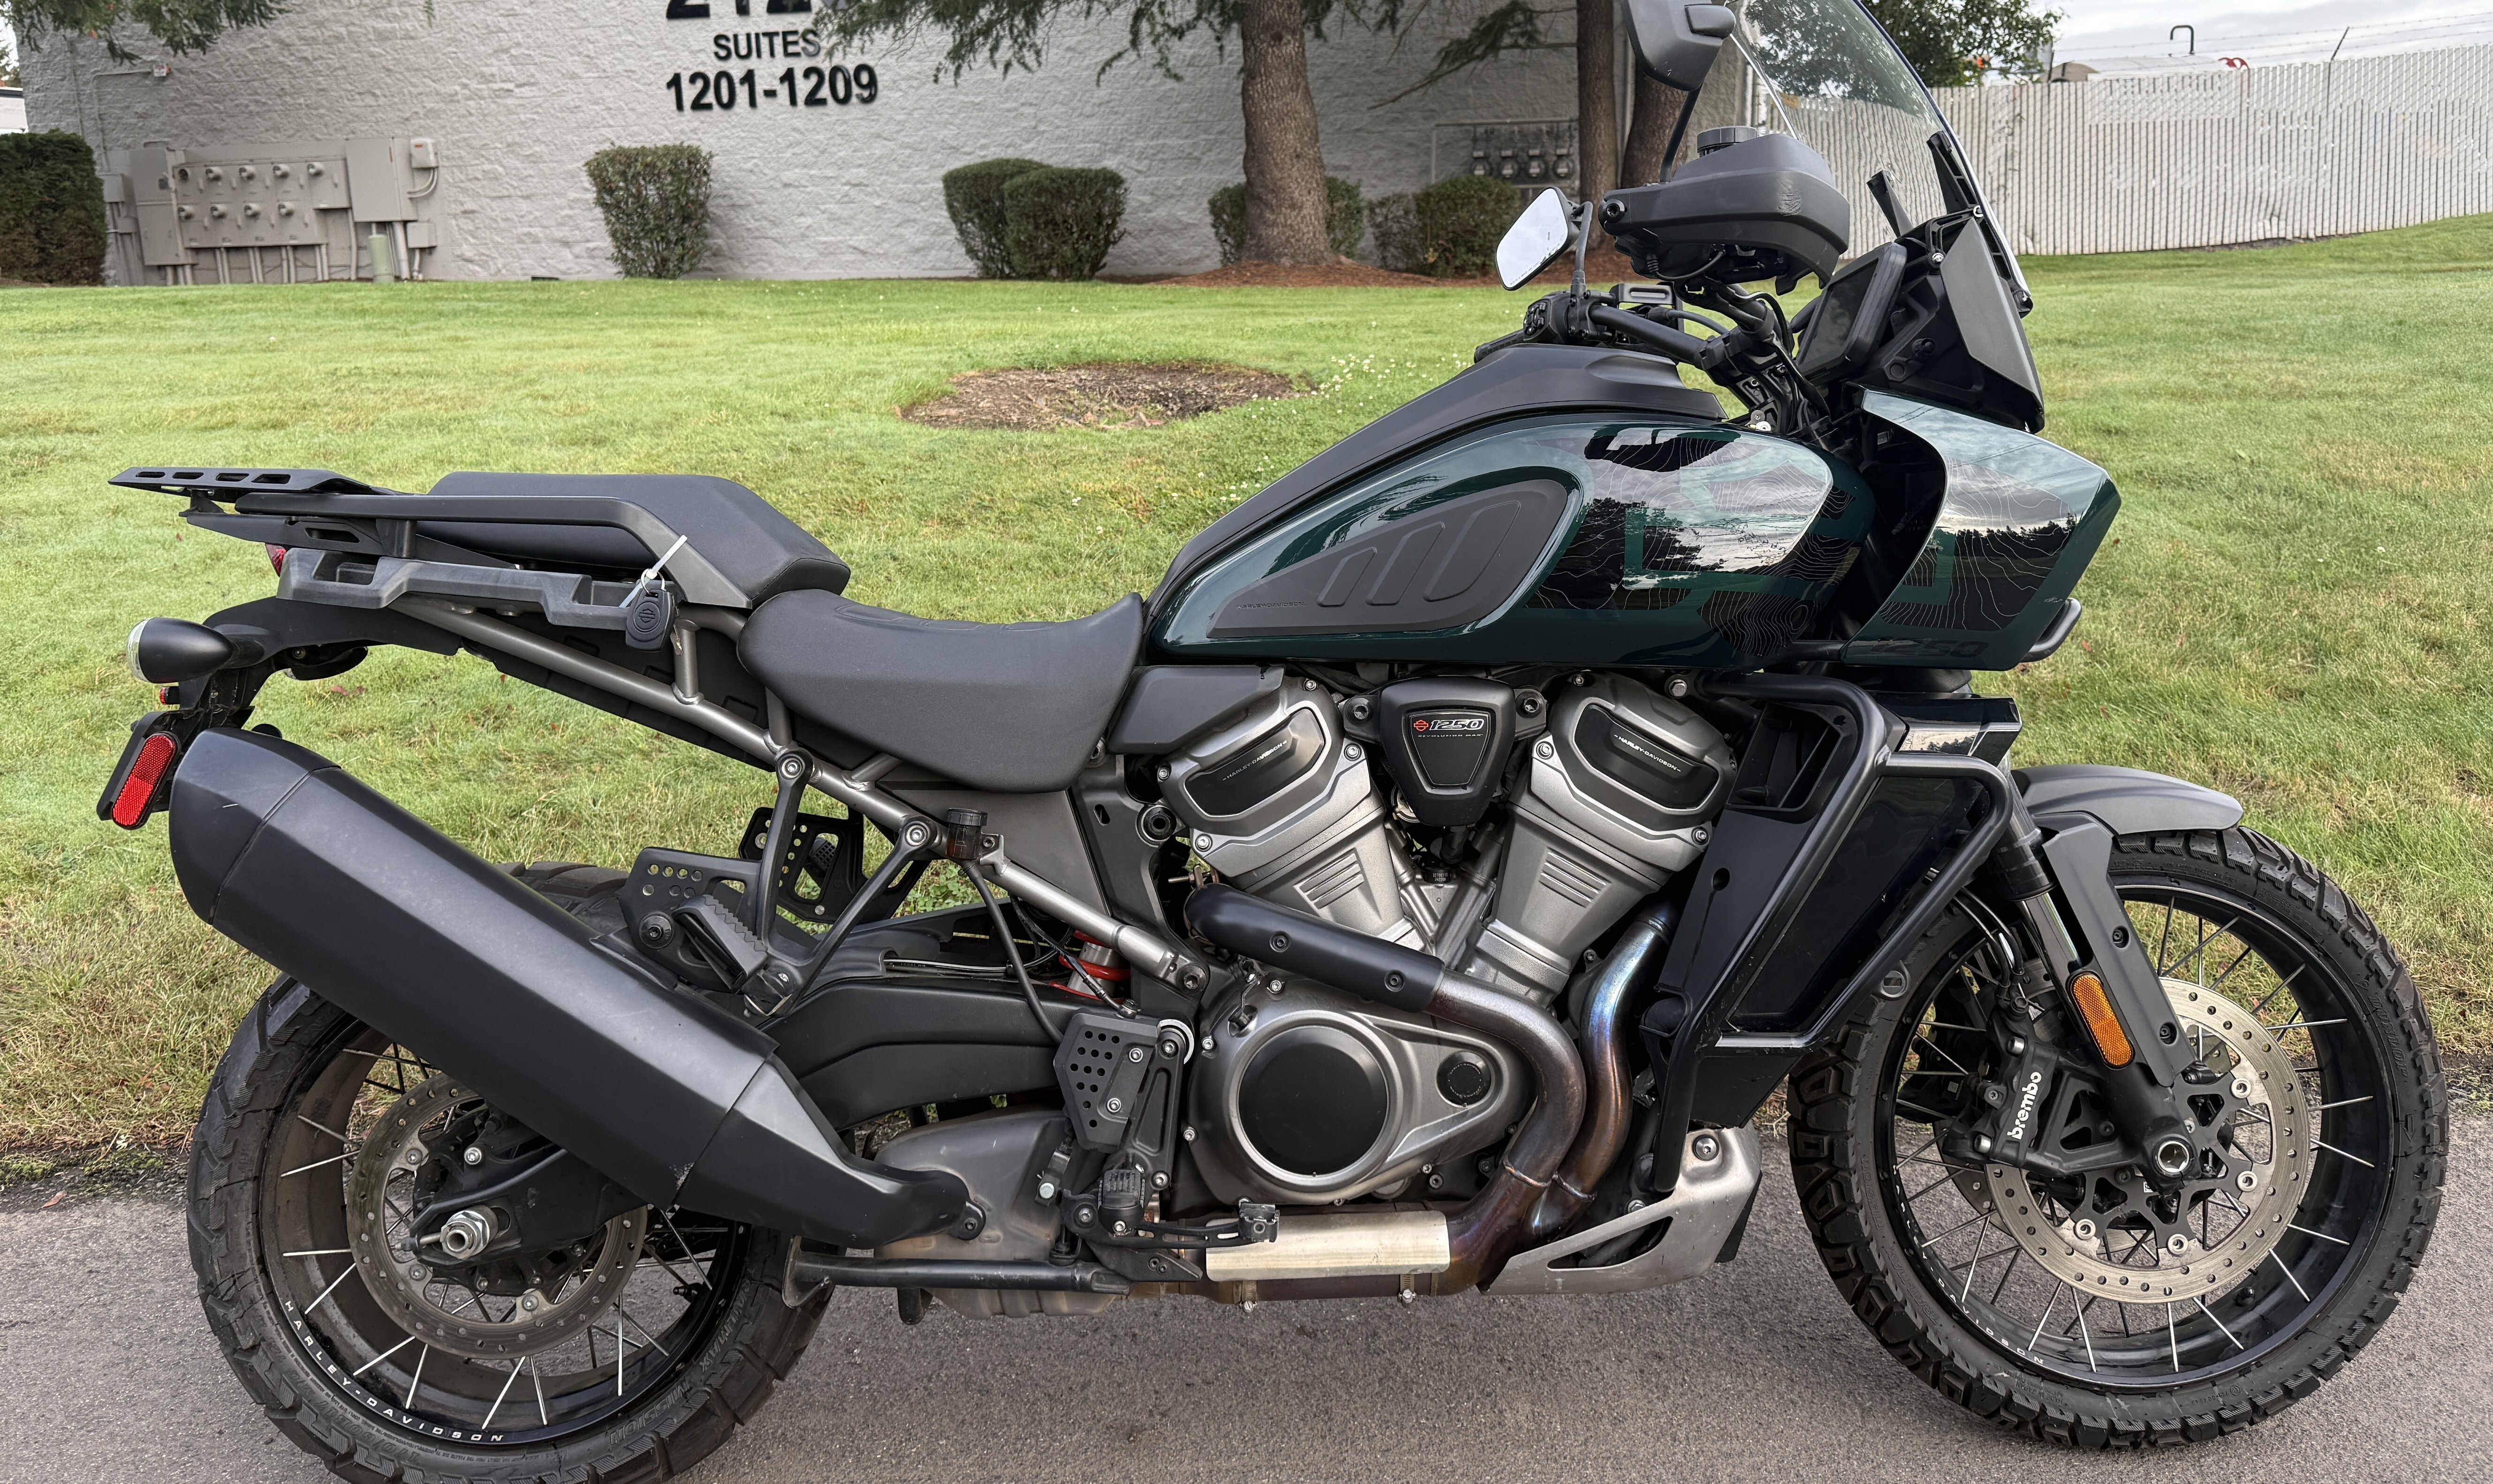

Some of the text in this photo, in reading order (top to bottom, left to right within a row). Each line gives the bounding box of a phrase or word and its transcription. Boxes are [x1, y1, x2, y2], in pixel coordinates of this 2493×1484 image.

[713, 30, 820, 61] SUITES
[667, 64, 878, 112] 1201-1209
[1429, 719, 1485, 730] 1250
[2369, 996, 2409, 1077] DUNLOP
[2007, 1072, 2041, 1140] brembo
[285, 1301, 504, 1442] HARLEY-DAVIDSON
[611, 1380, 690, 1445] MISSION
